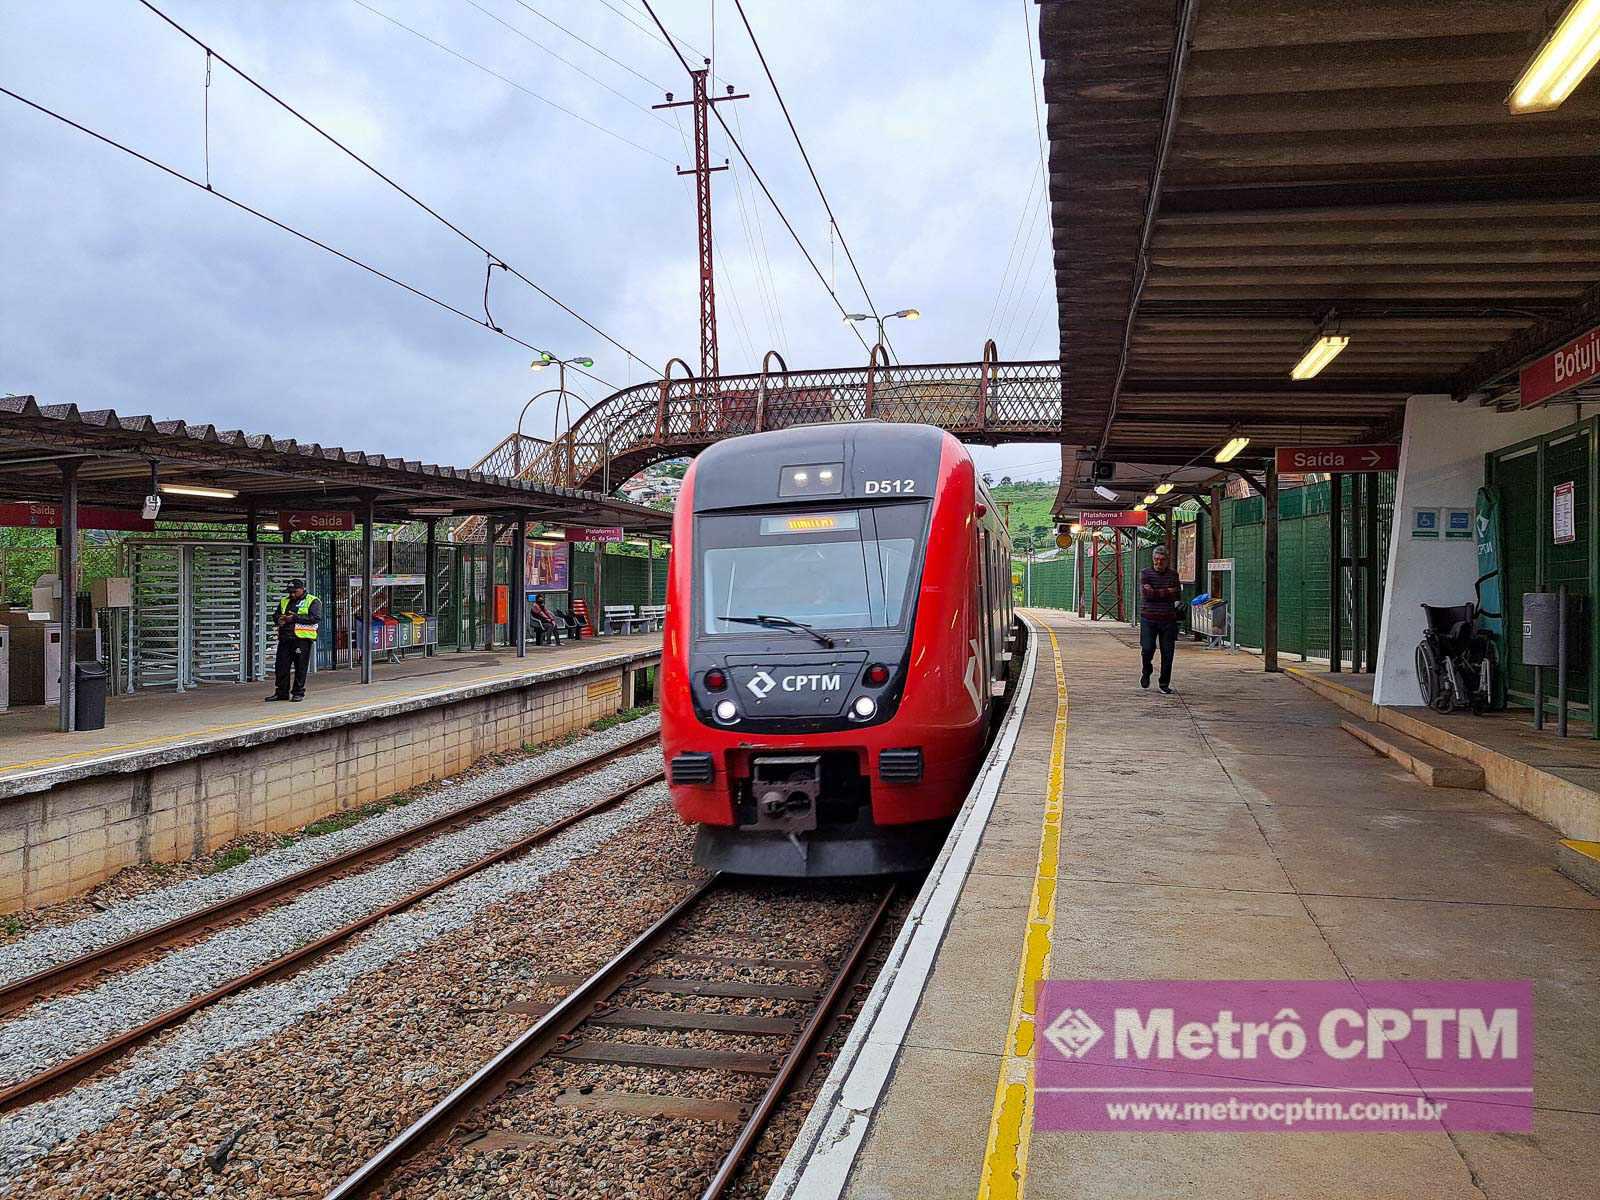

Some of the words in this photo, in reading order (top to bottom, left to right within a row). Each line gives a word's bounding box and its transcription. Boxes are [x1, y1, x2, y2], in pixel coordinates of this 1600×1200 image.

[1294, 452, 1345, 467] Saída
[865, 479, 915, 494] D512
[311, 514, 343, 526] Saída
[782, 674, 841, 692] CPTM
